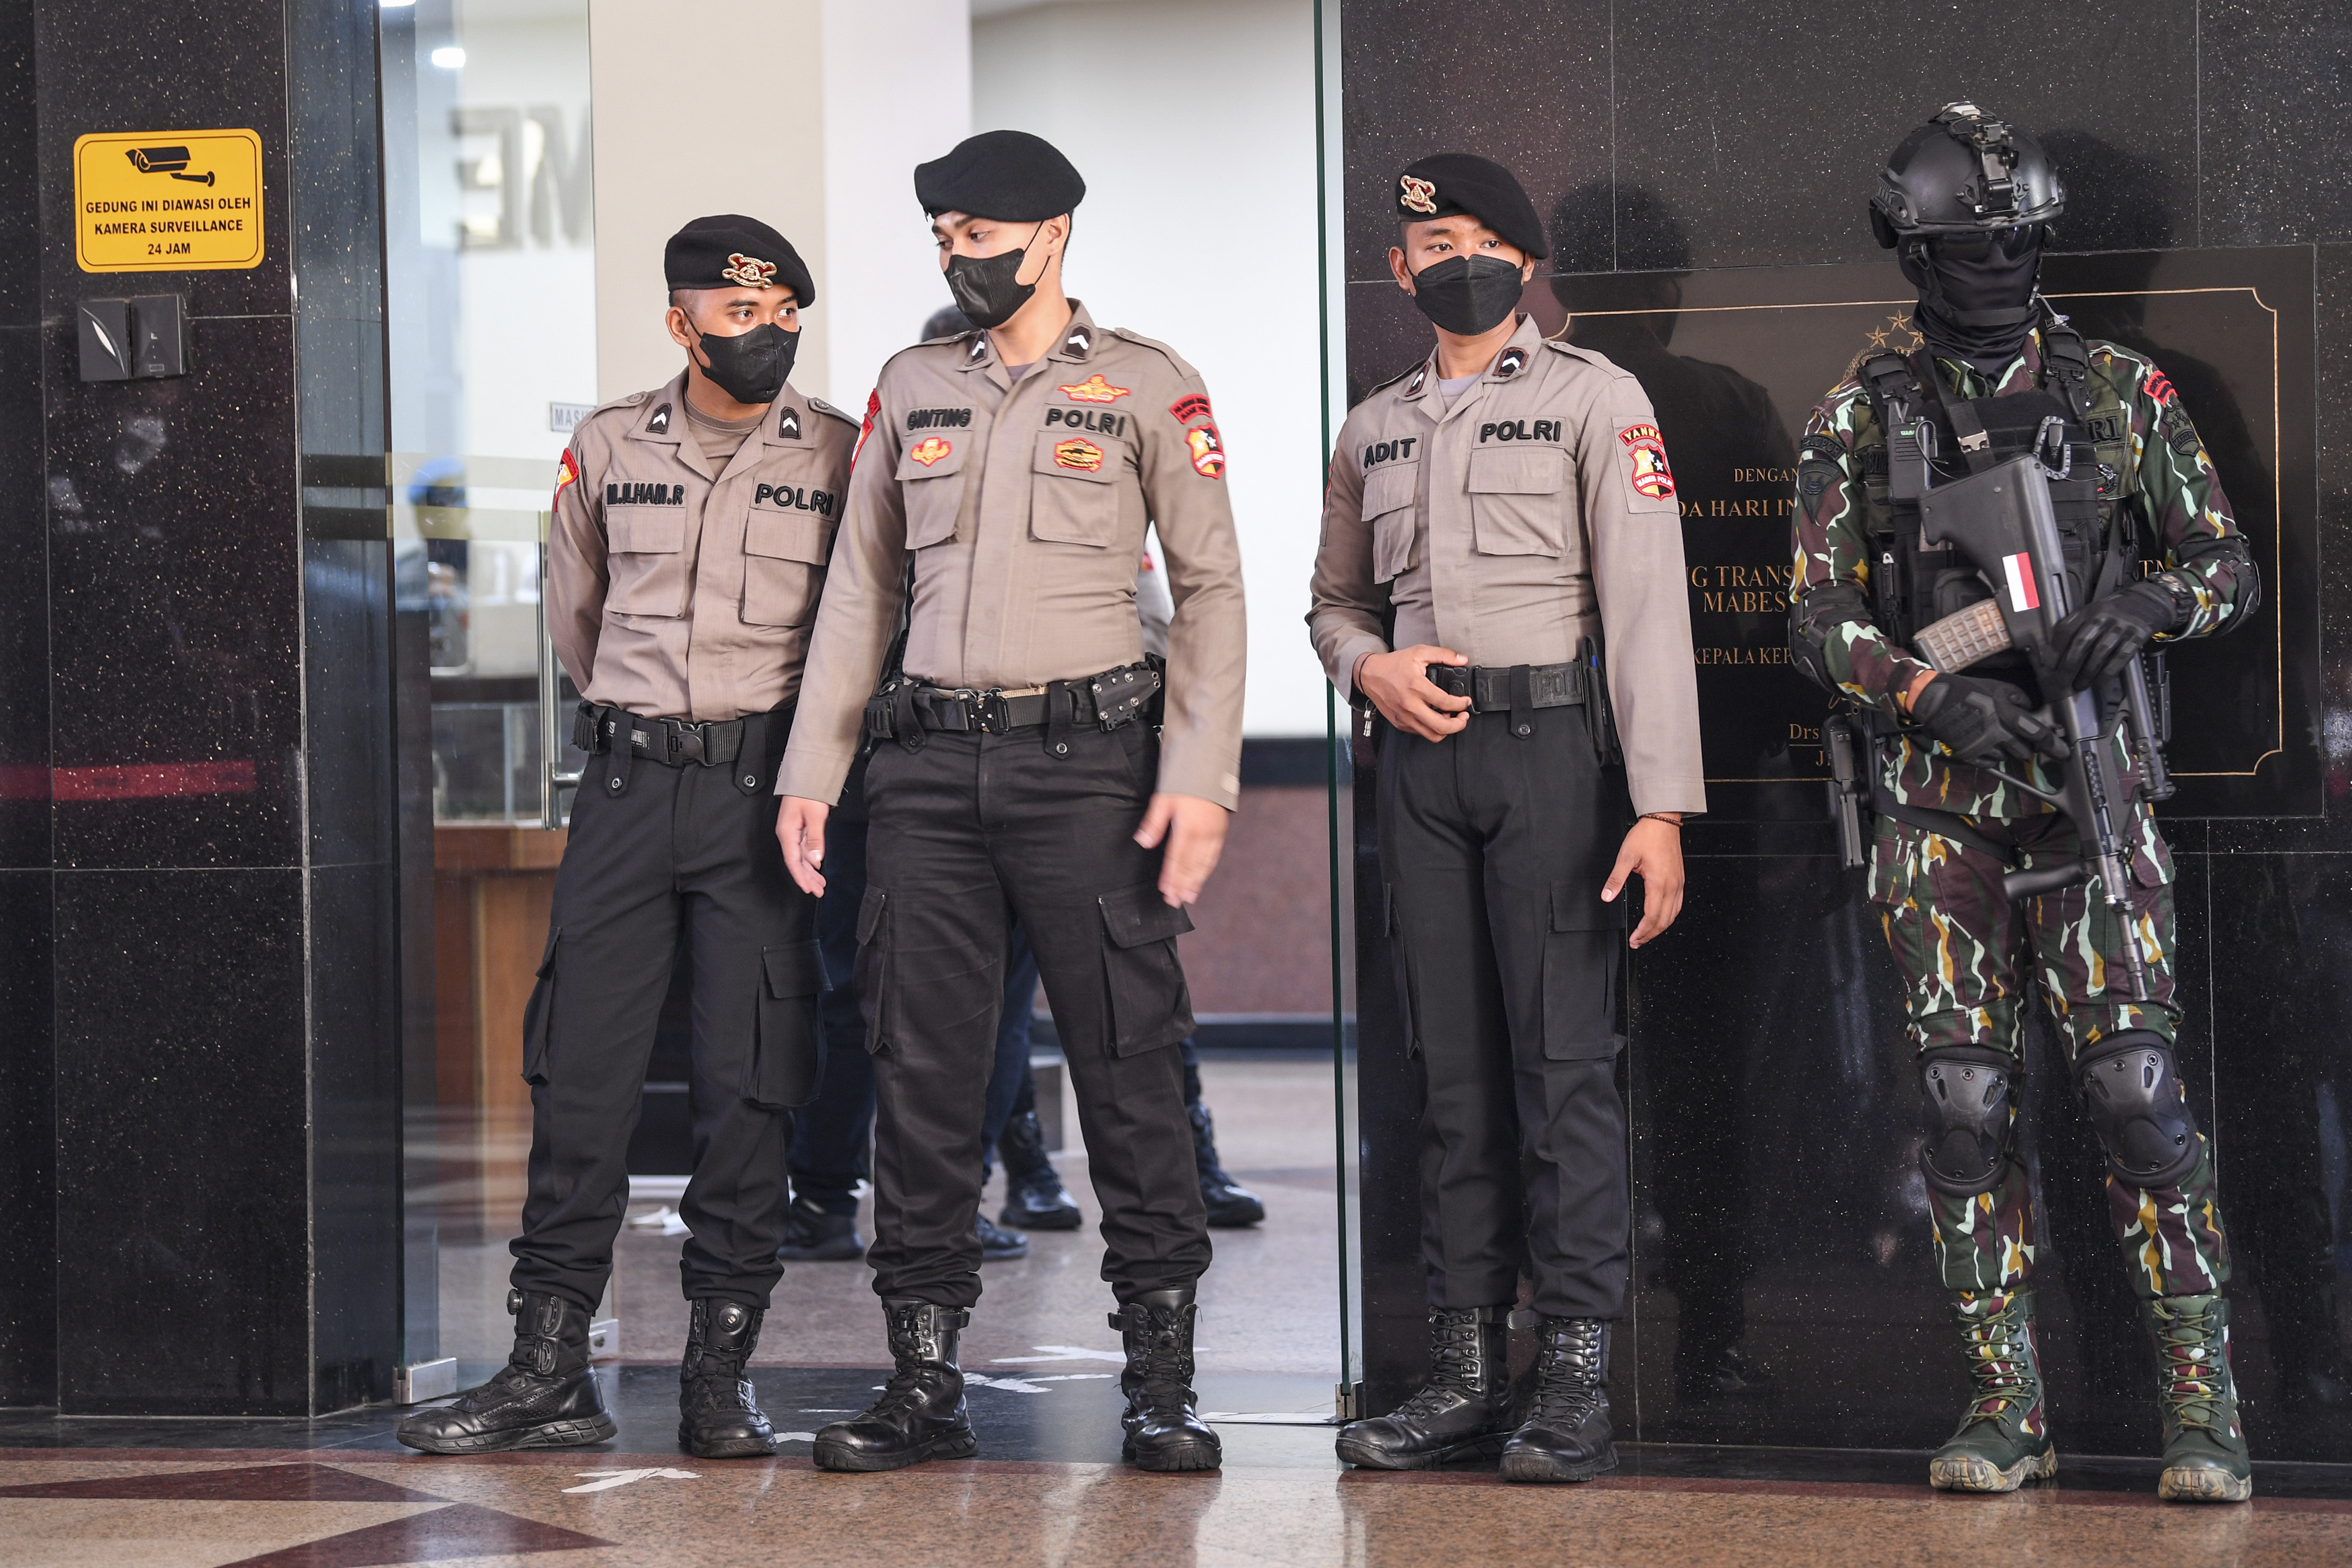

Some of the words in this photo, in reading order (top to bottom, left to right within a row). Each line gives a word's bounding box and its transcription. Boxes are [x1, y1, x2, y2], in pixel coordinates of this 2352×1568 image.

[86, 200, 137, 213] GEDUNG
[142, 200, 158, 212] INI
[163, 198, 214, 210] DIAWASI
[218, 198, 250, 209] OLEH
[95, 222, 146, 235] KAMERA
[151, 219, 243, 233] SURVEILLANCE
[148, 243, 162, 255] 24
[166, 243, 191, 254] JAM
[907, 408, 971, 430] GINTING
[1045, 408, 1125, 437] POLRI
[1480, 419, 1561, 443] POLRI
[1624, 427, 1661, 442] YANMA
[1363, 437, 1416, 469] ADIT
[1735, 467, 1799, 482] DENGAN
[755, 483, 833, 516] POLRI
[1711, 500, 1768, 517] HARI
[1715, 566, 1792, 587] TRANS
[1703, 591, 1786, 613] MABES
